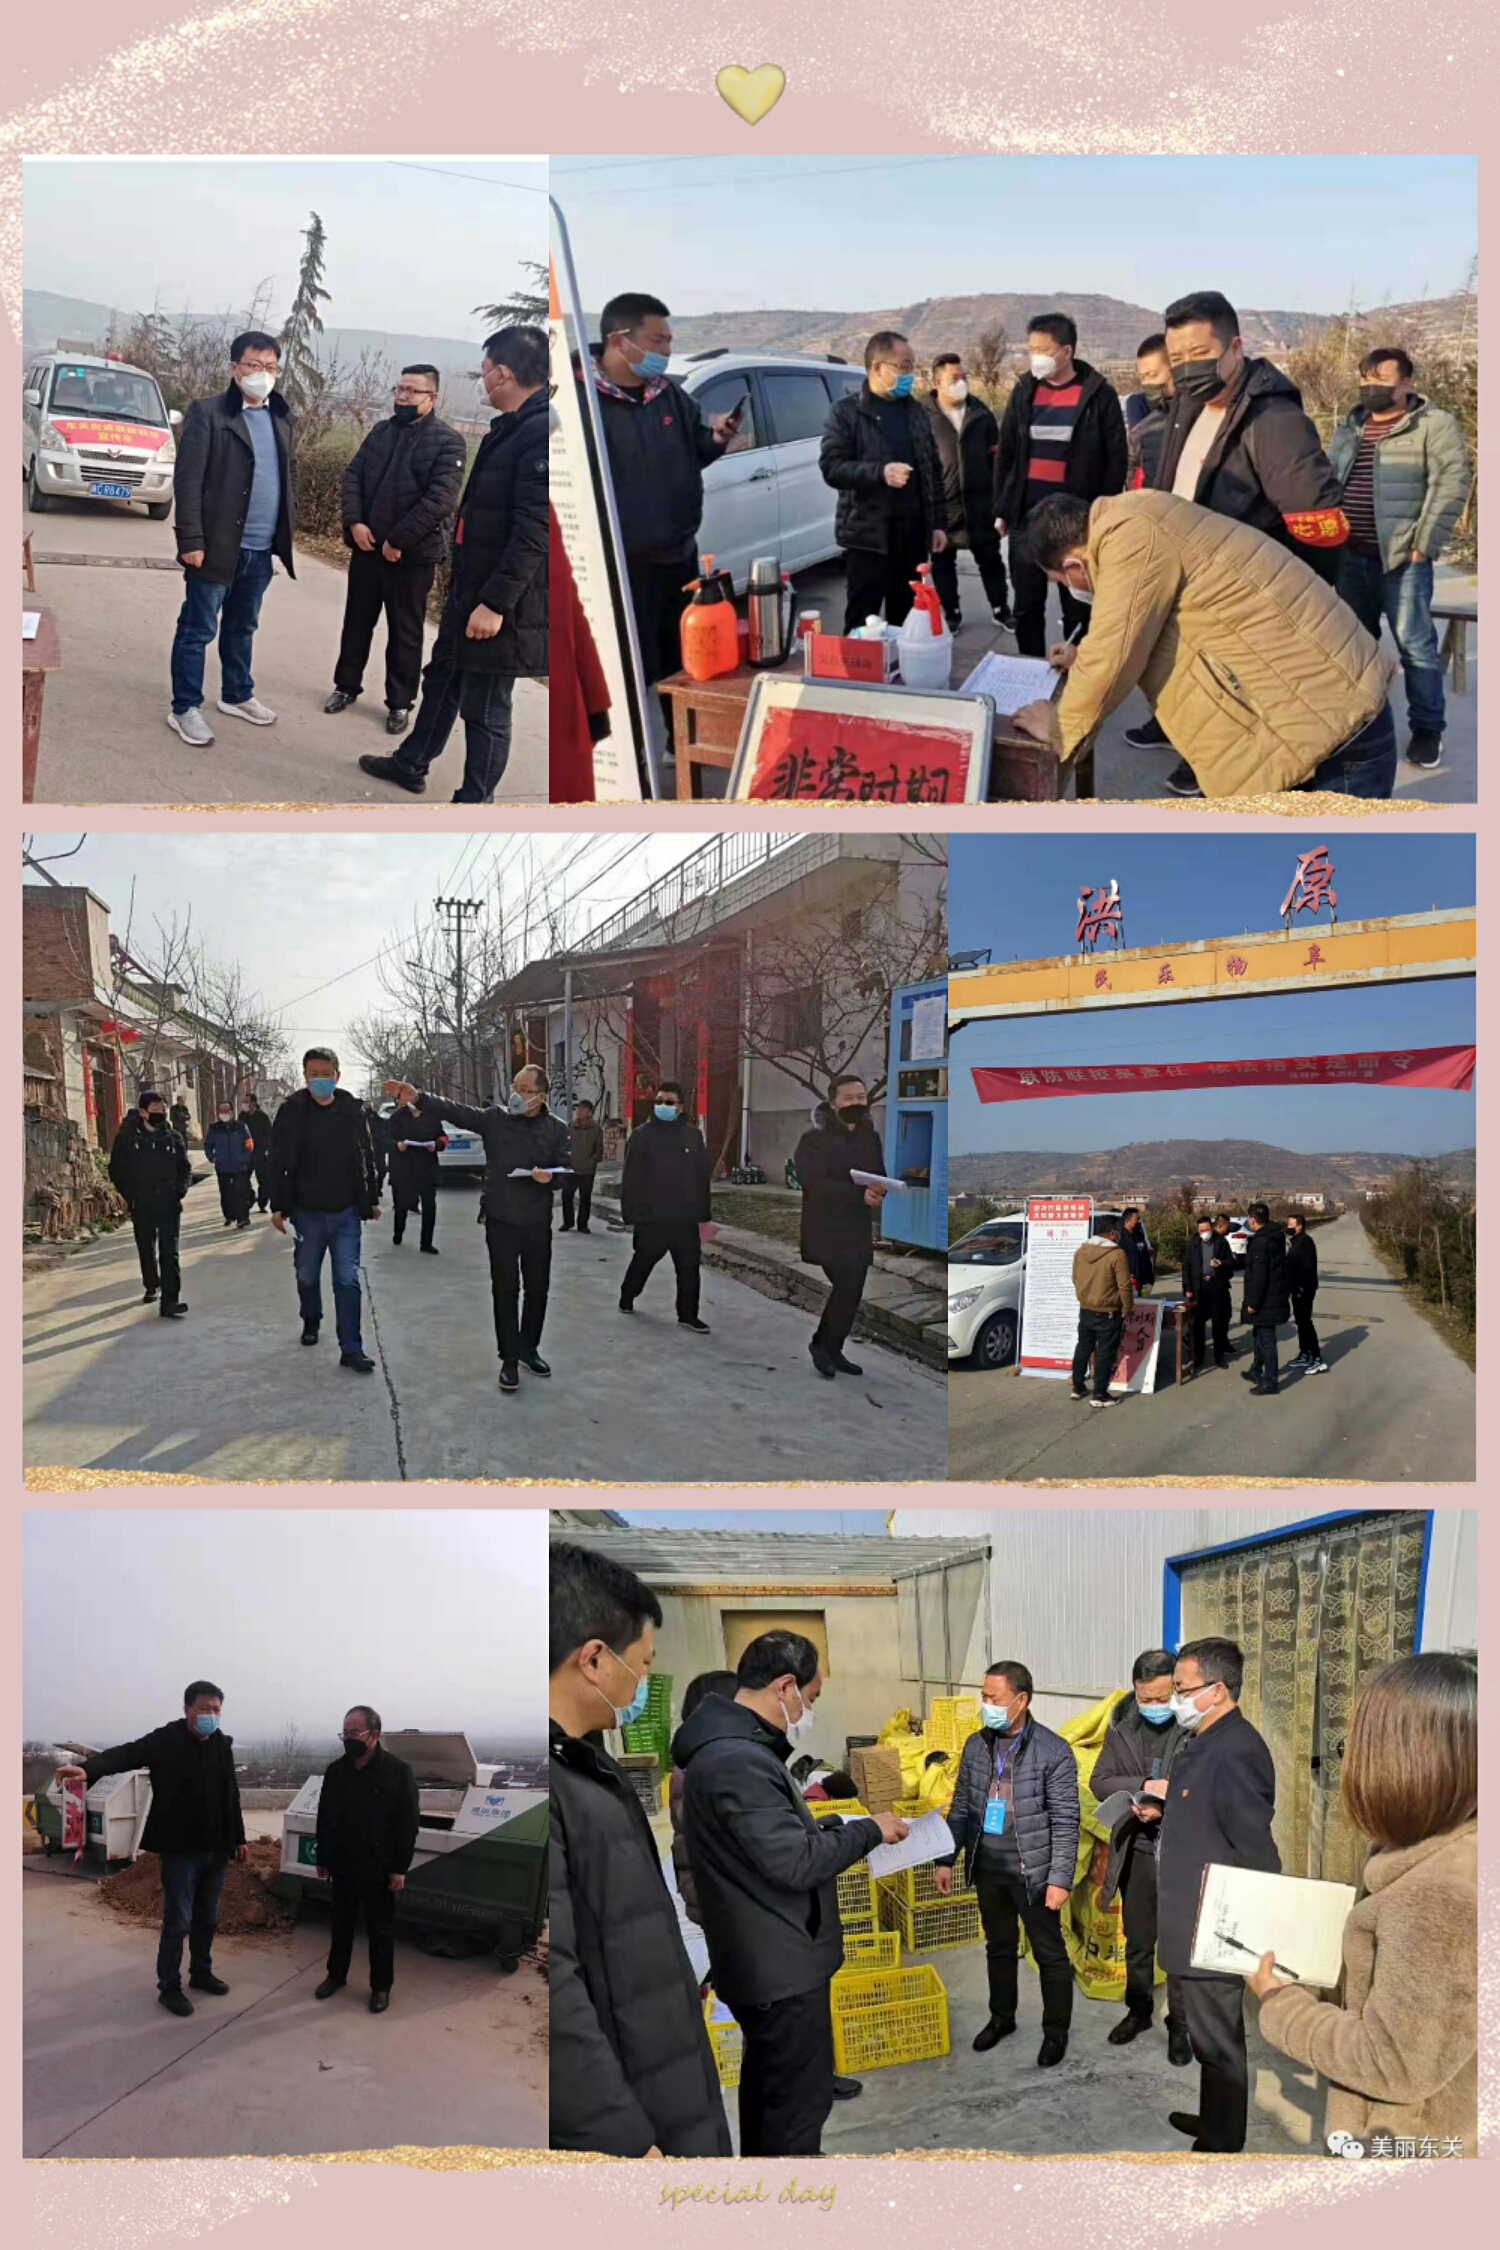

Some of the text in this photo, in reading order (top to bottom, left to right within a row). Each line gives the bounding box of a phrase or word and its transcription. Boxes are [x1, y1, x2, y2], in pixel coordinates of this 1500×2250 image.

[772, 746, 949, 802] 非常时期
[1094, 943, 1325, 990] 民乐物阜
[1017, 1053, 1415, 1085] 联防联控是责任 依法落实是命令
